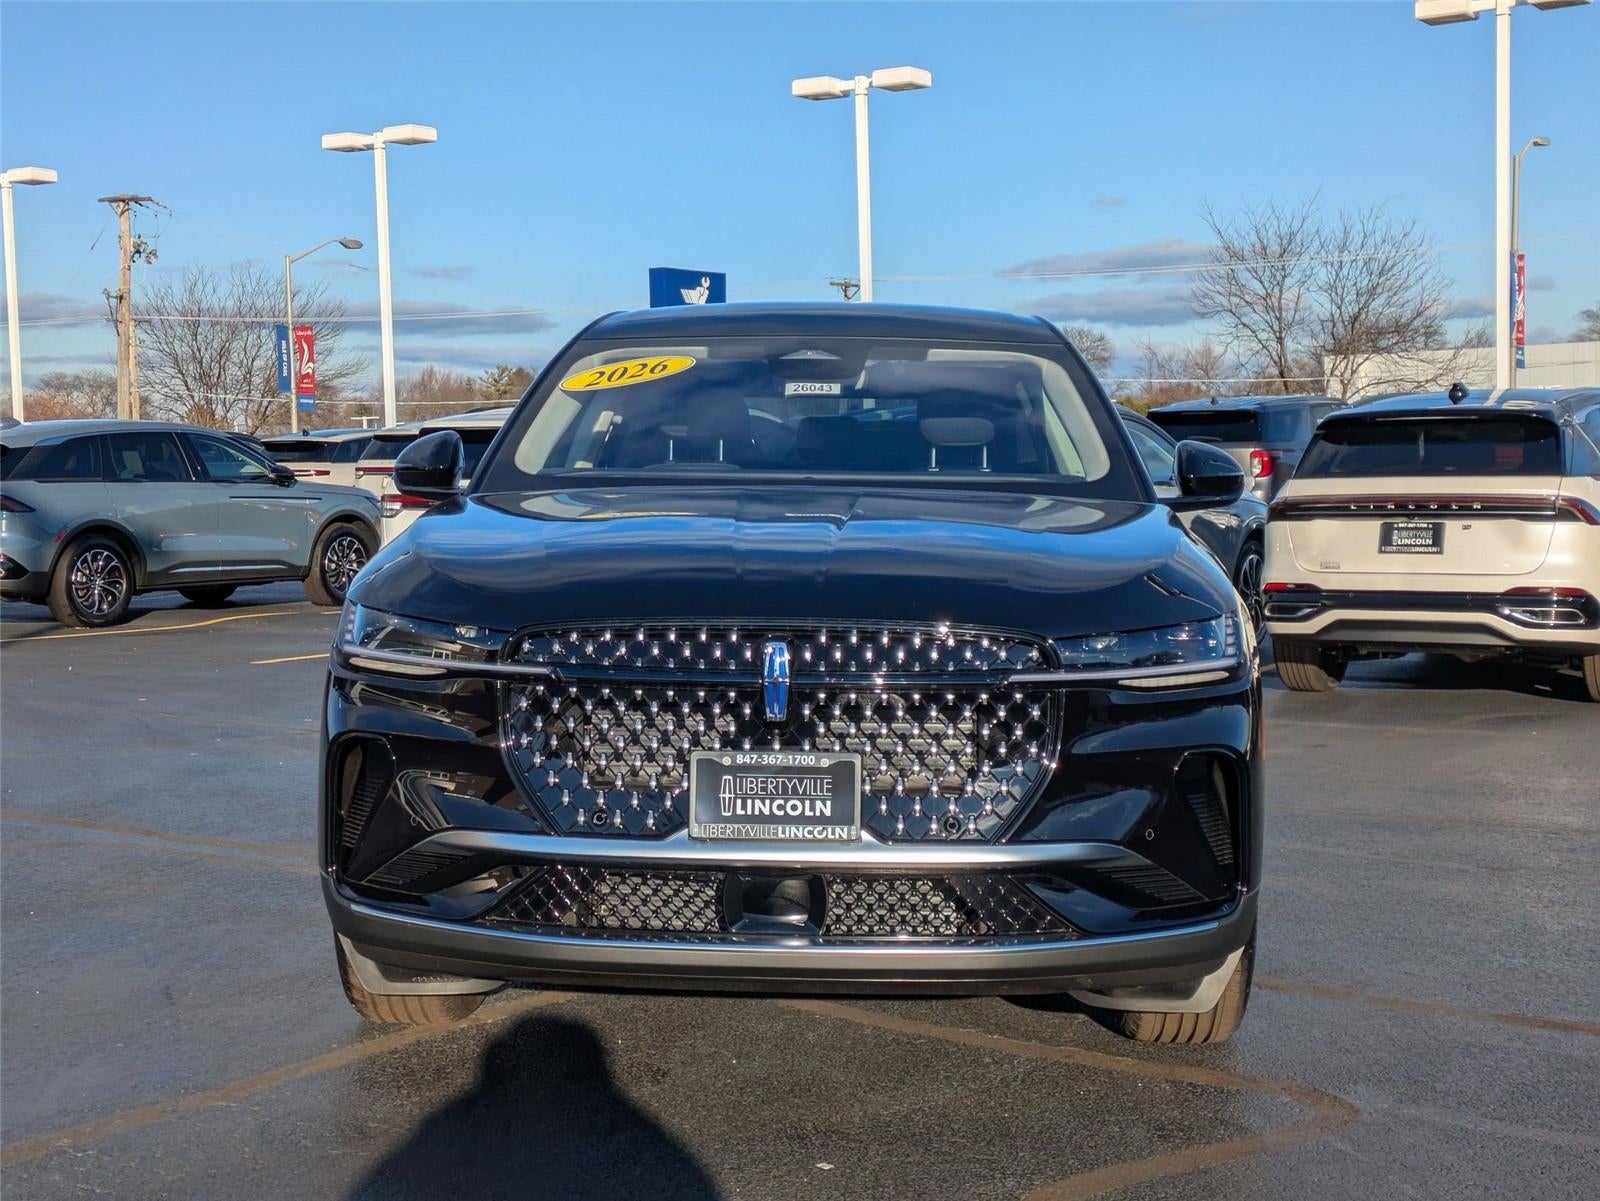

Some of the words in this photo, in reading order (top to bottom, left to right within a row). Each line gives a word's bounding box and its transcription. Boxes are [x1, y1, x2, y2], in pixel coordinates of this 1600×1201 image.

[584, 360, 669, 388] 2026
[793, 383, 833, 393] 26043
[736, 754, 815, 765] 847-367-1700
[736, 778, 833, 796] LIBERTYVILLE
[736, 799, 832, 817] LINCOLN
